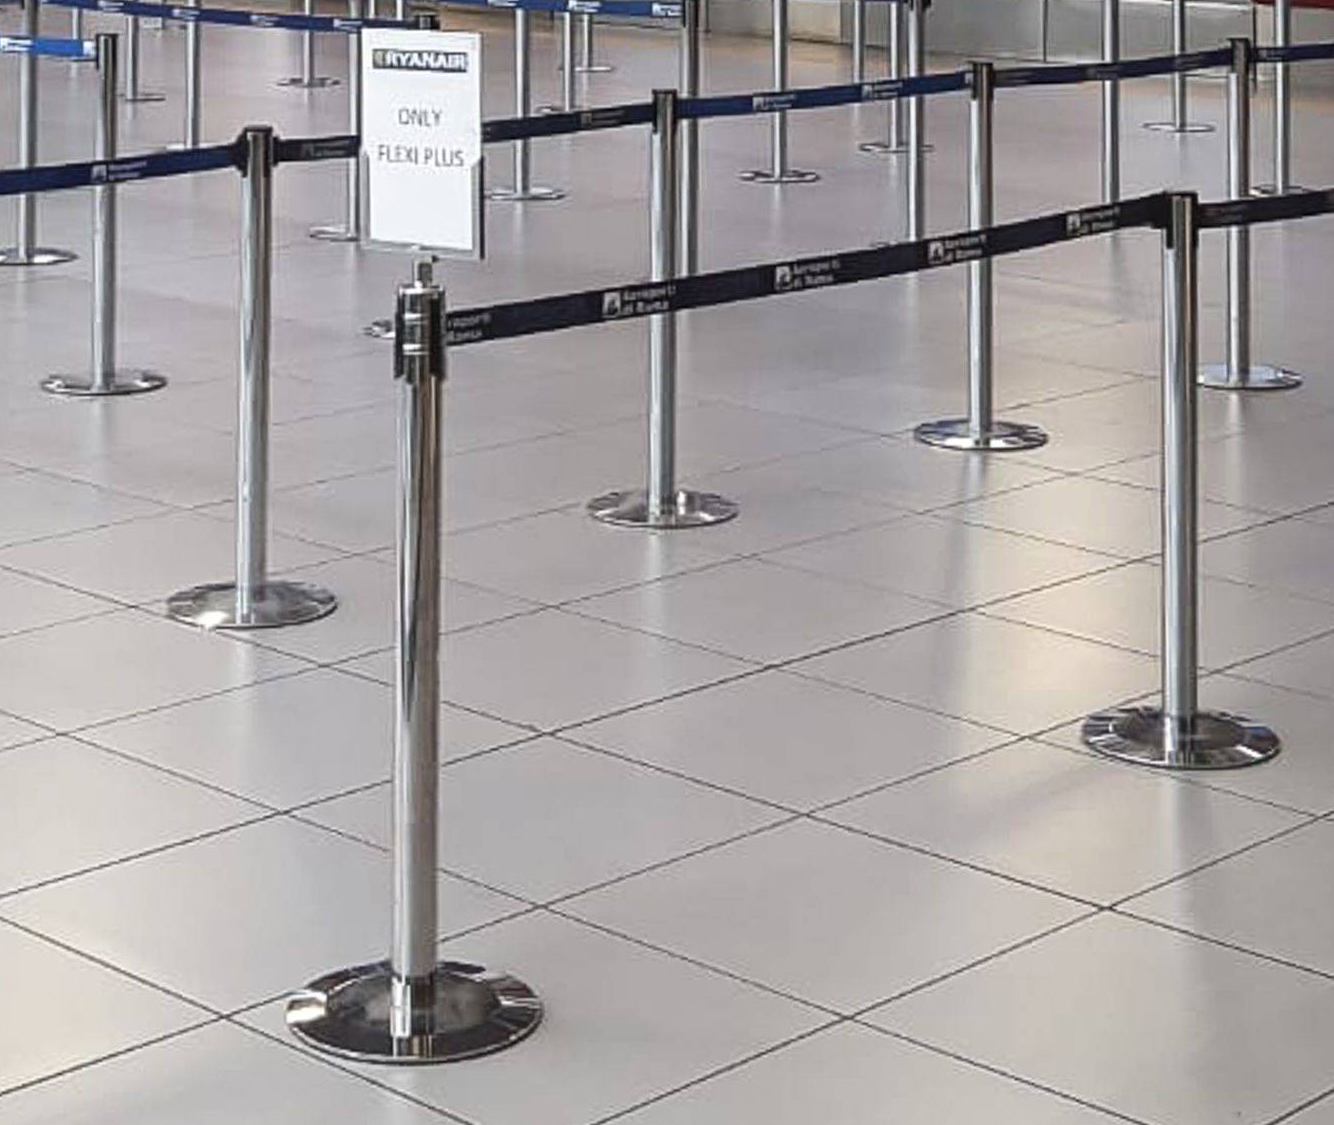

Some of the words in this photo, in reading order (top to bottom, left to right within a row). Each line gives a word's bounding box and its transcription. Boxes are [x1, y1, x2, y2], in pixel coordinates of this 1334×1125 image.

[385, 51, 466, 71] RYANAIR
[397, 107, 443, 127] ONLY
[378, 144, 419, 166] FLEXI
[424, 147, 465, 168] PLUS
